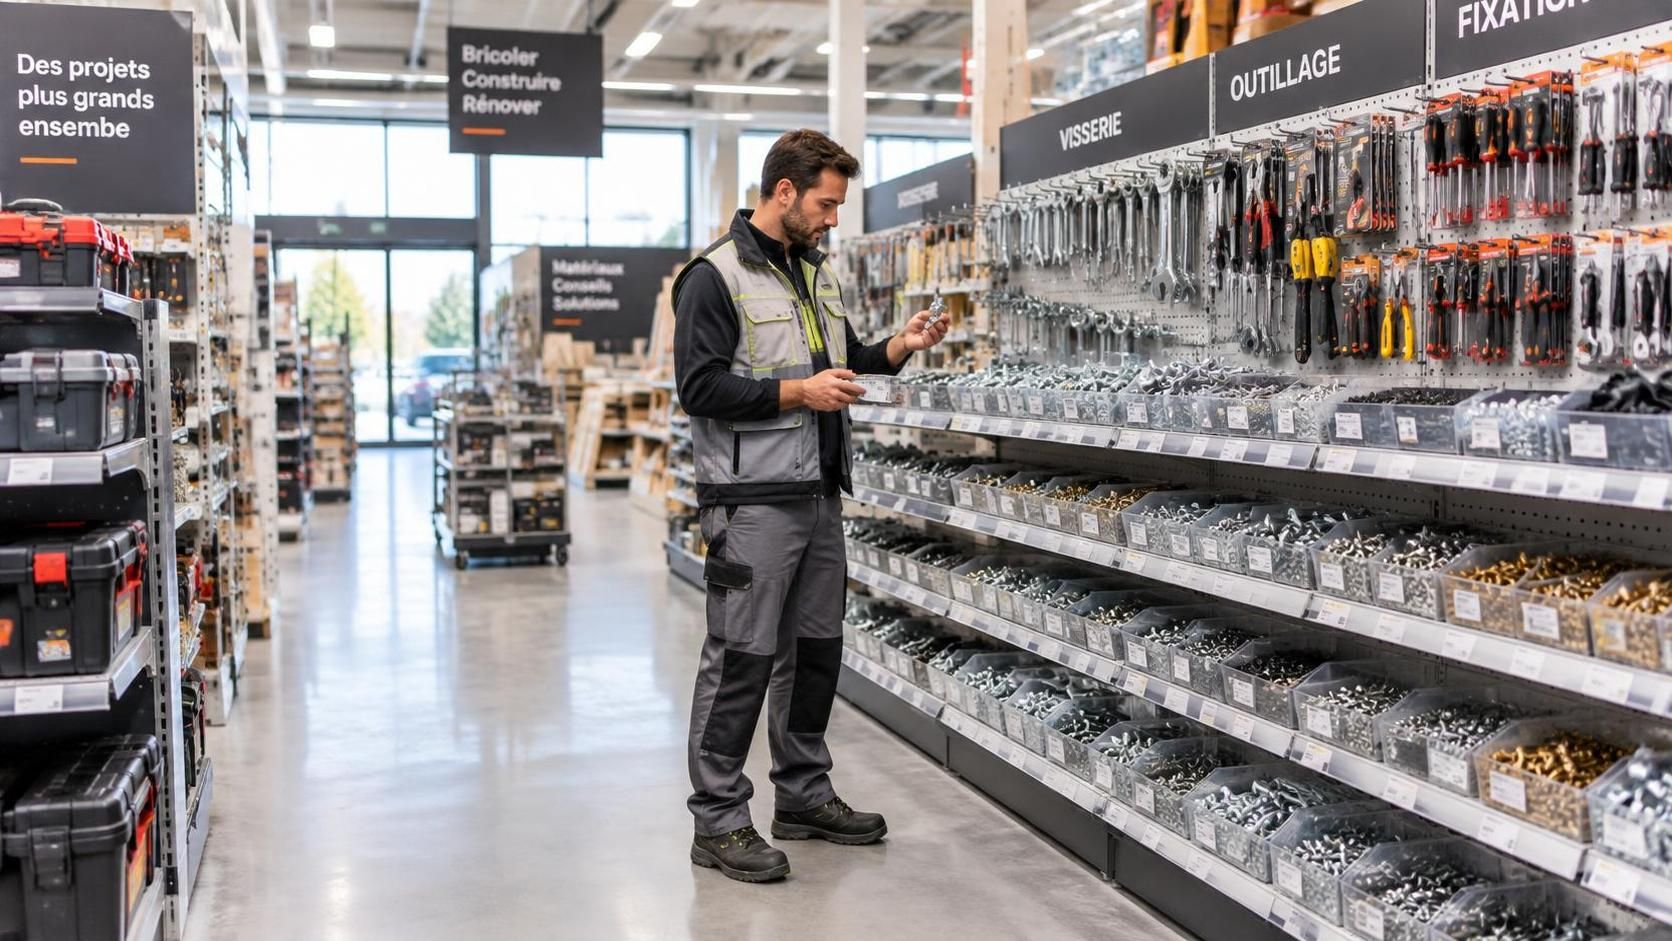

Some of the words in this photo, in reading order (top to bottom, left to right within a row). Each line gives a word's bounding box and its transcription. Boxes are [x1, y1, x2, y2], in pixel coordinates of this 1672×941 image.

[1458, 0, 1590, 39] FIXA
[17, 53, 63, 75] Des
[69, 57, 151, 83] projets
[462, 45, 539, 66] Bricoler
[462, 69, 562, 91] Construire
[1230, 44, 1341, 102] OUTILLAGE
[18, 84, 68, 109] plus
[73, 88, 155, 112] grands
[462, 93, 542, 115] Rénover
[18, 116, 131, 138] ensembe
[1059, 111, 1122, 151] VISSERIE
